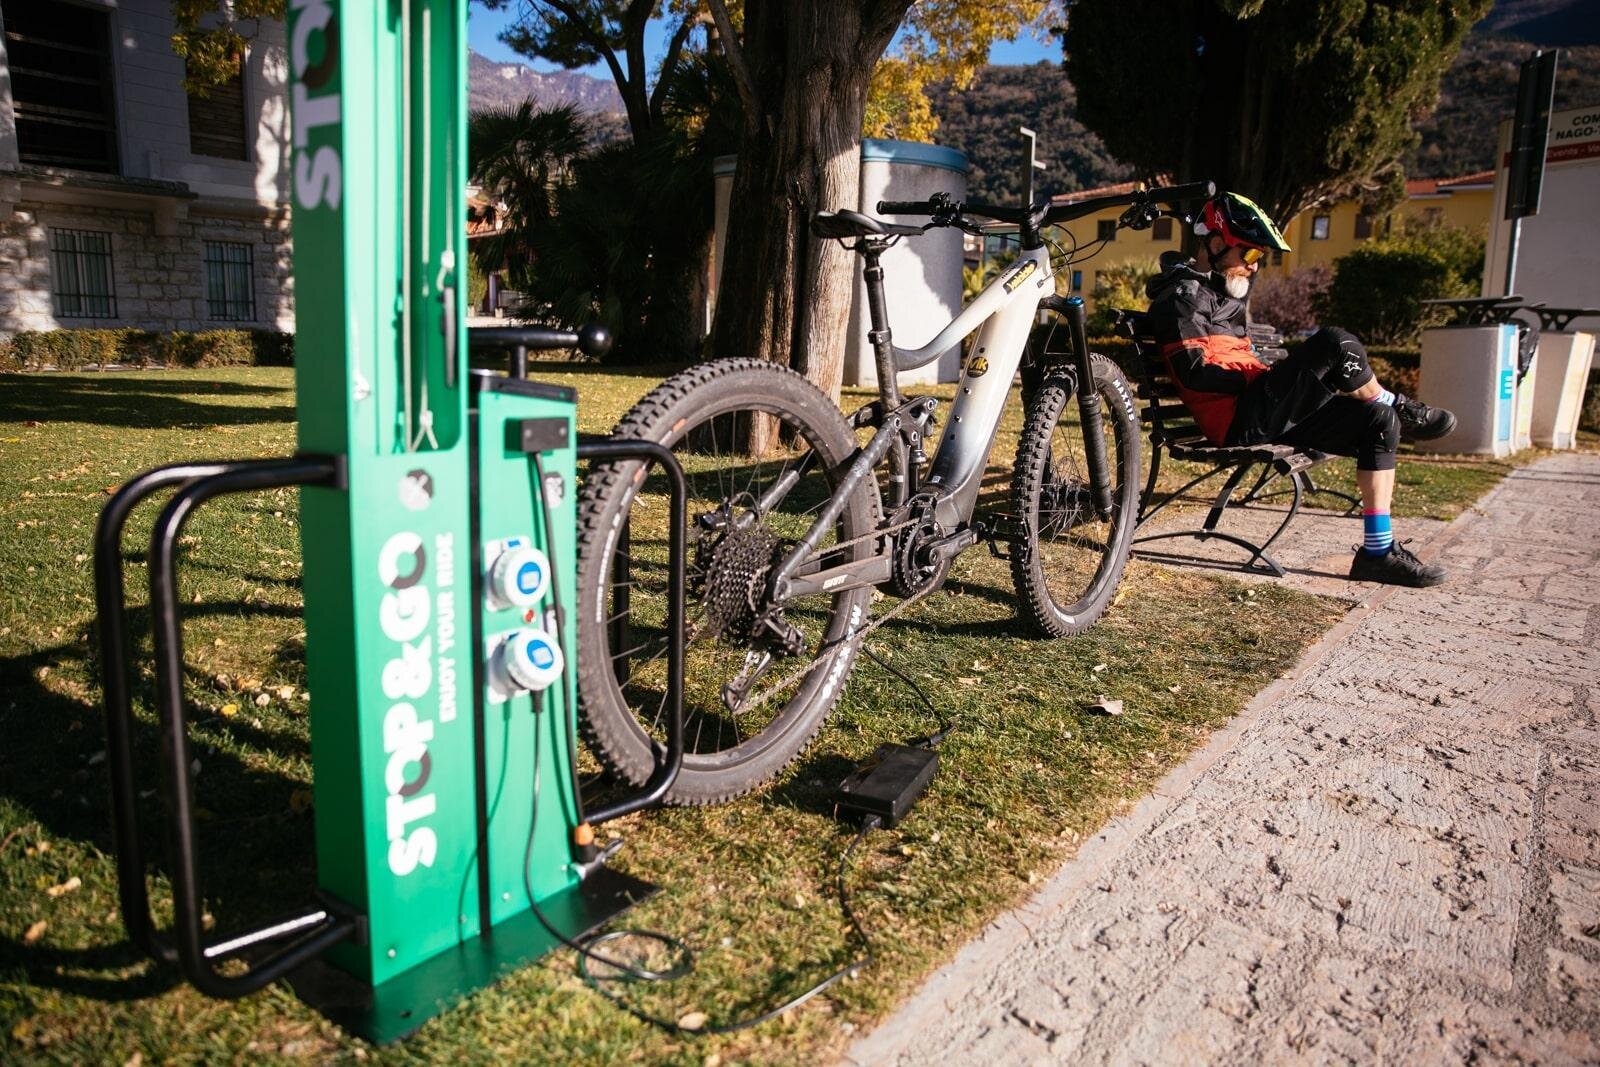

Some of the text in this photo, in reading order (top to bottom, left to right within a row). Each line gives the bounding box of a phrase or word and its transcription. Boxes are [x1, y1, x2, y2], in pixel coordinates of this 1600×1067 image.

[291, 0, 341, 210] STO
[1555, 125, 1600, 140] NAGO-
[1113, 379, 1135, 421] MAXXIS
[378, 531, 437, 876] STOP&GO
[435, 531, 457, 722] ENJOY YOUR RIDE
